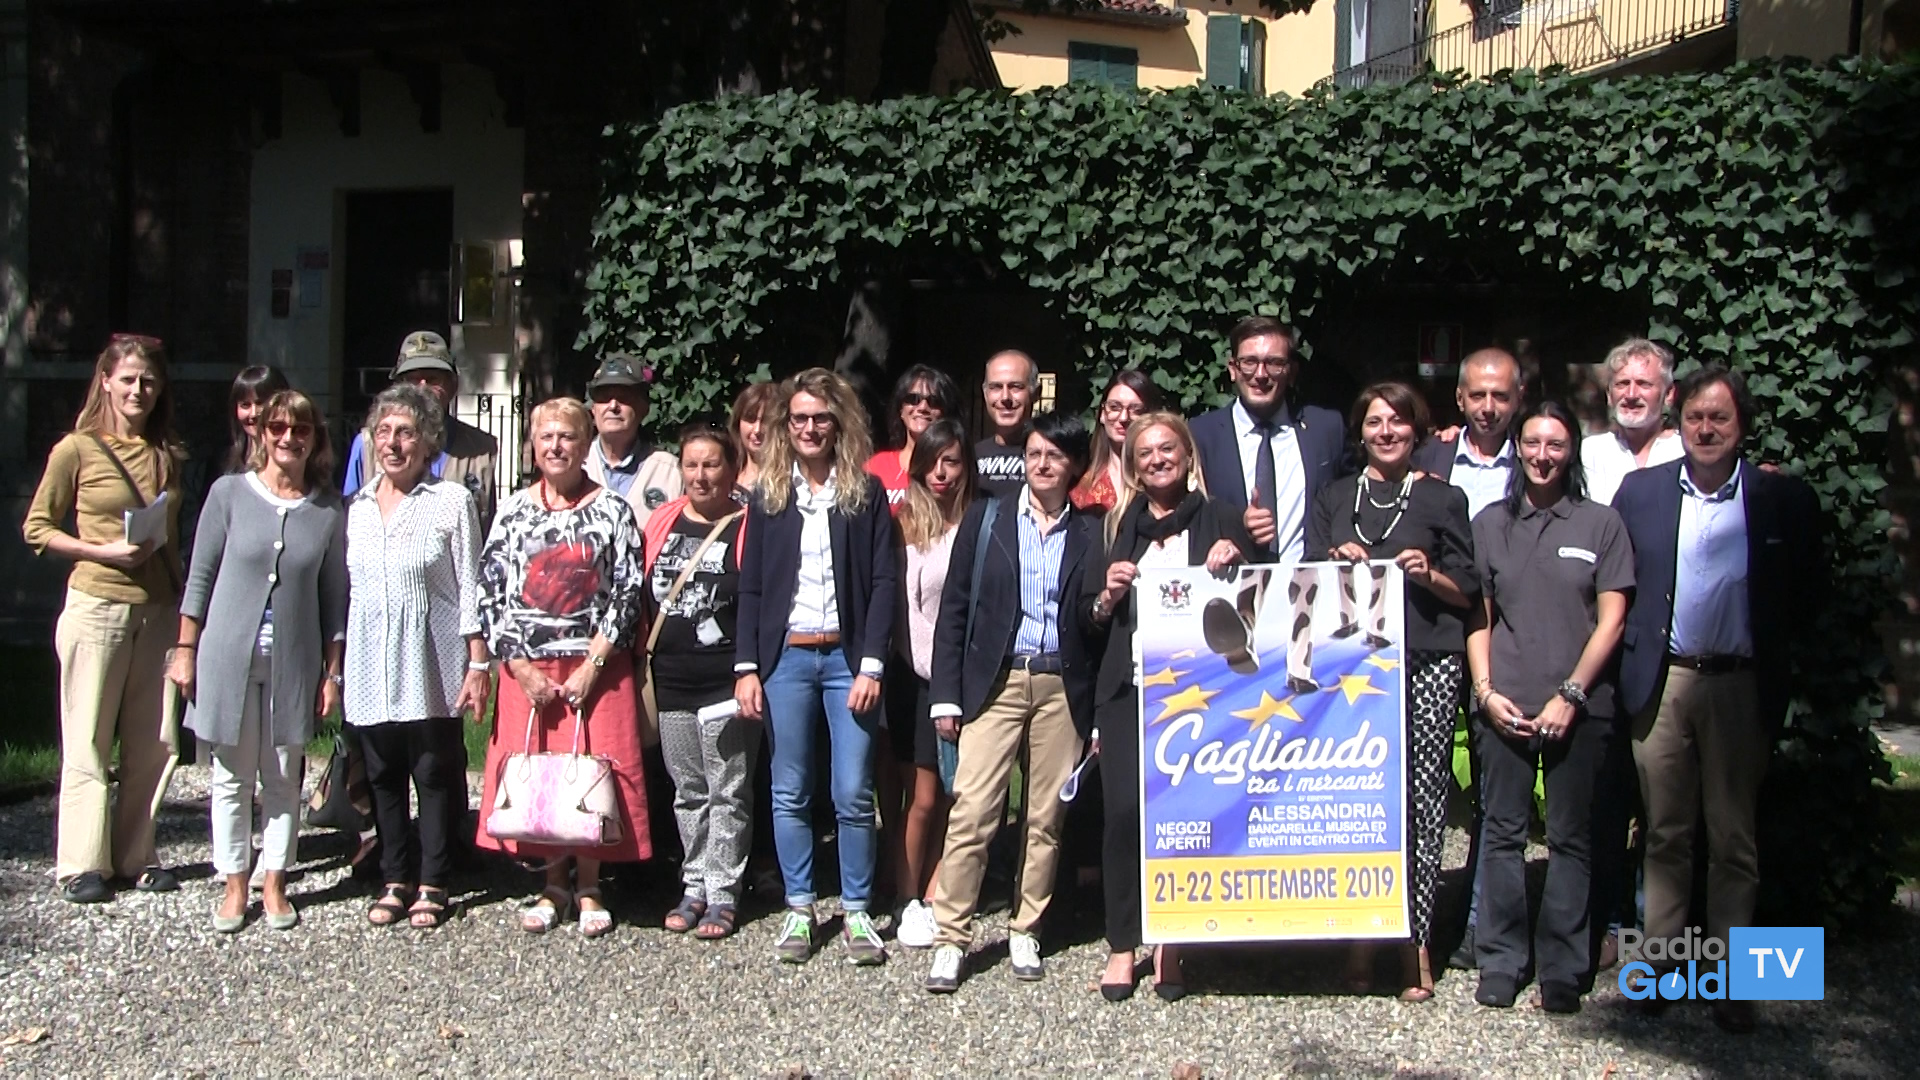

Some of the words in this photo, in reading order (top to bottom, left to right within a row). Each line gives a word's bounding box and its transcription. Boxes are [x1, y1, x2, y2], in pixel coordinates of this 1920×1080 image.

[1154, 713, 1388, 787] Gagliaudo
[1246, 775, 1281, 794] tra
[1296, 771, 1386, 792] mercanti
[1248, 803, 1387, 822] ALESSANDRIA
[1155, 821, 1211, 836] NEGOZI
[1325, 821, 1370, 832] MUSICA
[1371, 821, 1387, 832] ED
[1155, 835, 1211, 850] APERTI!
[1247, 836, 1288, 848] EVENTI
[1289, 836, 1302, 847] IN
[1303, 833, 1350, 846] CENTRO
[1154, 871, 1213, 902] 21-22
[1220, 867, 1338, 901] SETTEMBRE
[1345, 865, 1395, 898] 2019
